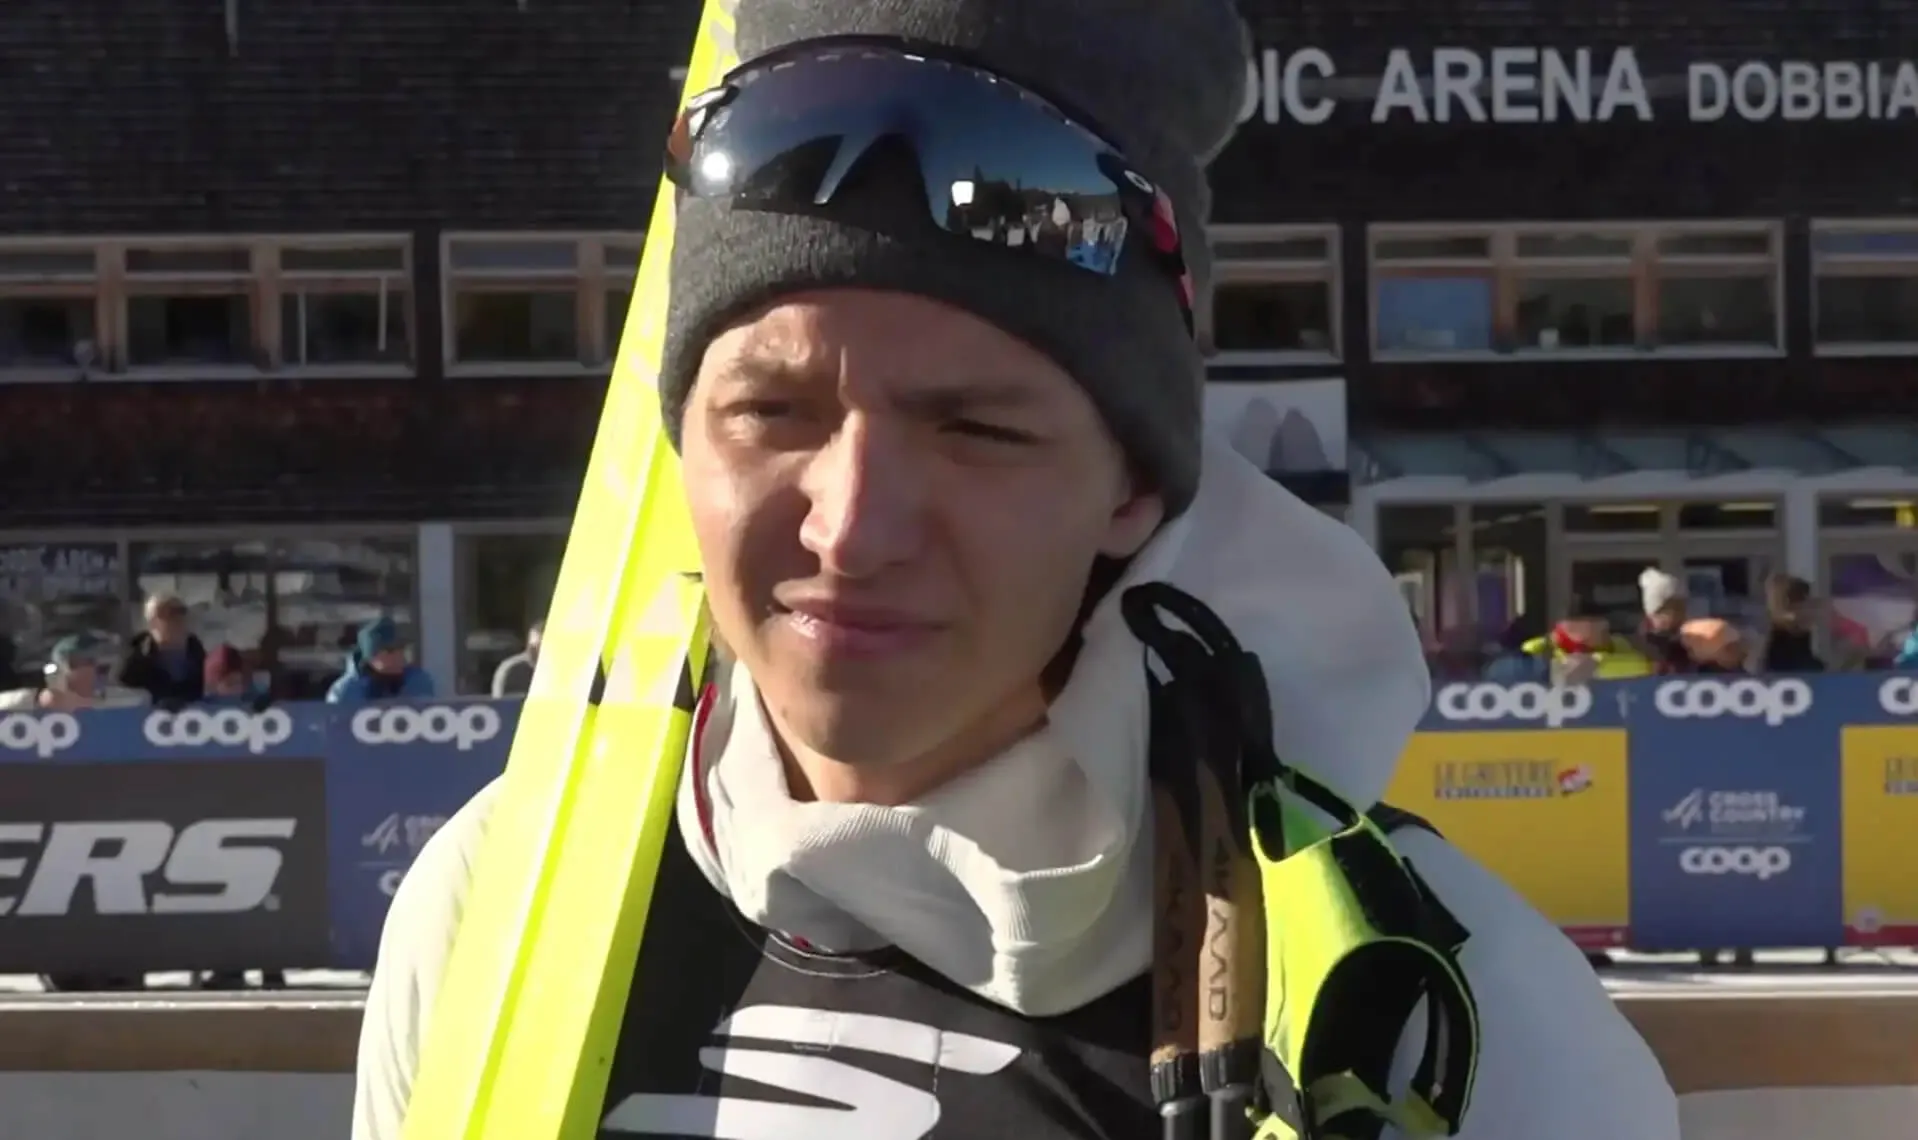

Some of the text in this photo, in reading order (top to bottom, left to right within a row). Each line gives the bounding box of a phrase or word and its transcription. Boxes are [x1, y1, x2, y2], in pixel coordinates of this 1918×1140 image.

[1240, 47, 1918, 124] IC ARENA DOBBIA
[1437, 682, 1592, 727] coop
[1655, 678, 1812, 726] coop
[144, 709, 291, 753] coop
[352, 705, 499, 750] coop
[1679, 846, 1791, 880] coop
